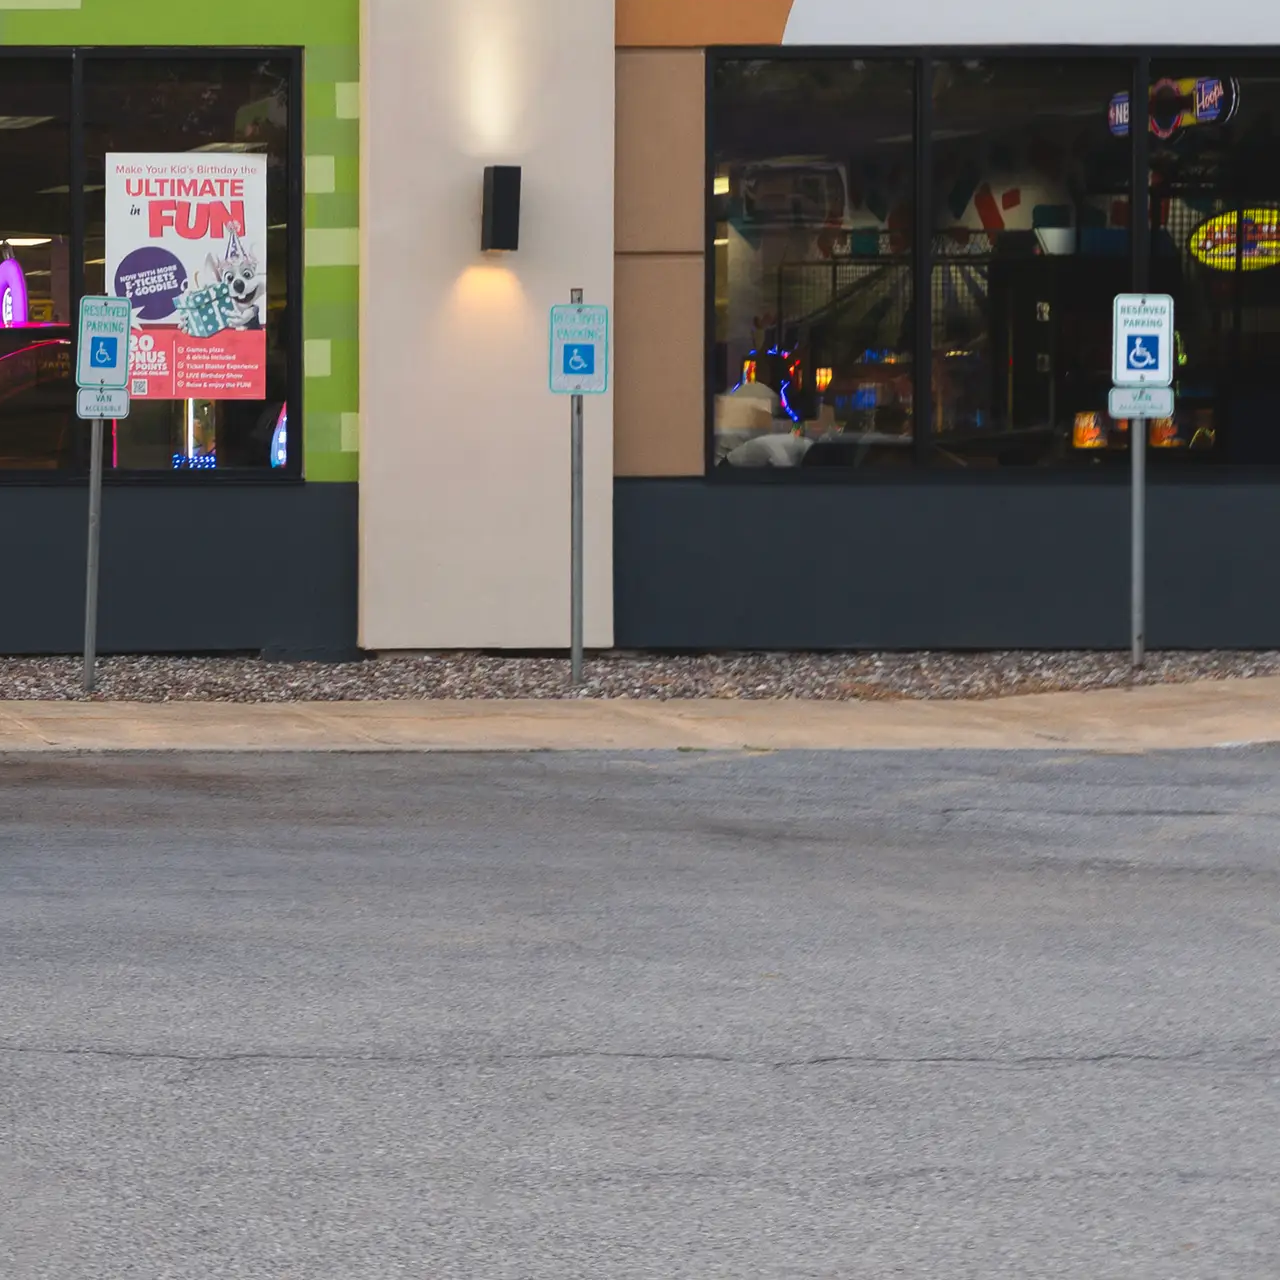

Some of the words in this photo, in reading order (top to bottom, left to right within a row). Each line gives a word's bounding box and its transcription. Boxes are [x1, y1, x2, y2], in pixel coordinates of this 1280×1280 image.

[115, 165, 143, 175] Make
[145, 165, 168, 175] Your
[170, 165, 194, 175] Kid's
[197, 165, 238, 177] Birthday
[240, 165, 257, 175] the
[125, 178, 245, 197] ULTIMATE
[130, 204, 141, 216] in
[148, 199, 246, 240] FUN
[120, 273, 137, 283] NOW
[137, 269, 156, 279] WITH
[156, 264, 178, 275] MORE
[125, 272, 175, 290] E-TICKETS
[134, 279, 179, 296] GOODIES
[83, 305, 128, 317] RESERVED
[1120, 305, 1167, 316] RESERVED
[86, 320, 124, 333] PARKING
[1123, 318, 1163, 328] PARKING
[128, 351, 167, 363] ONUS
[135, 363, 168, 371] POINTS
[96, 394, 112, 403] VAN
